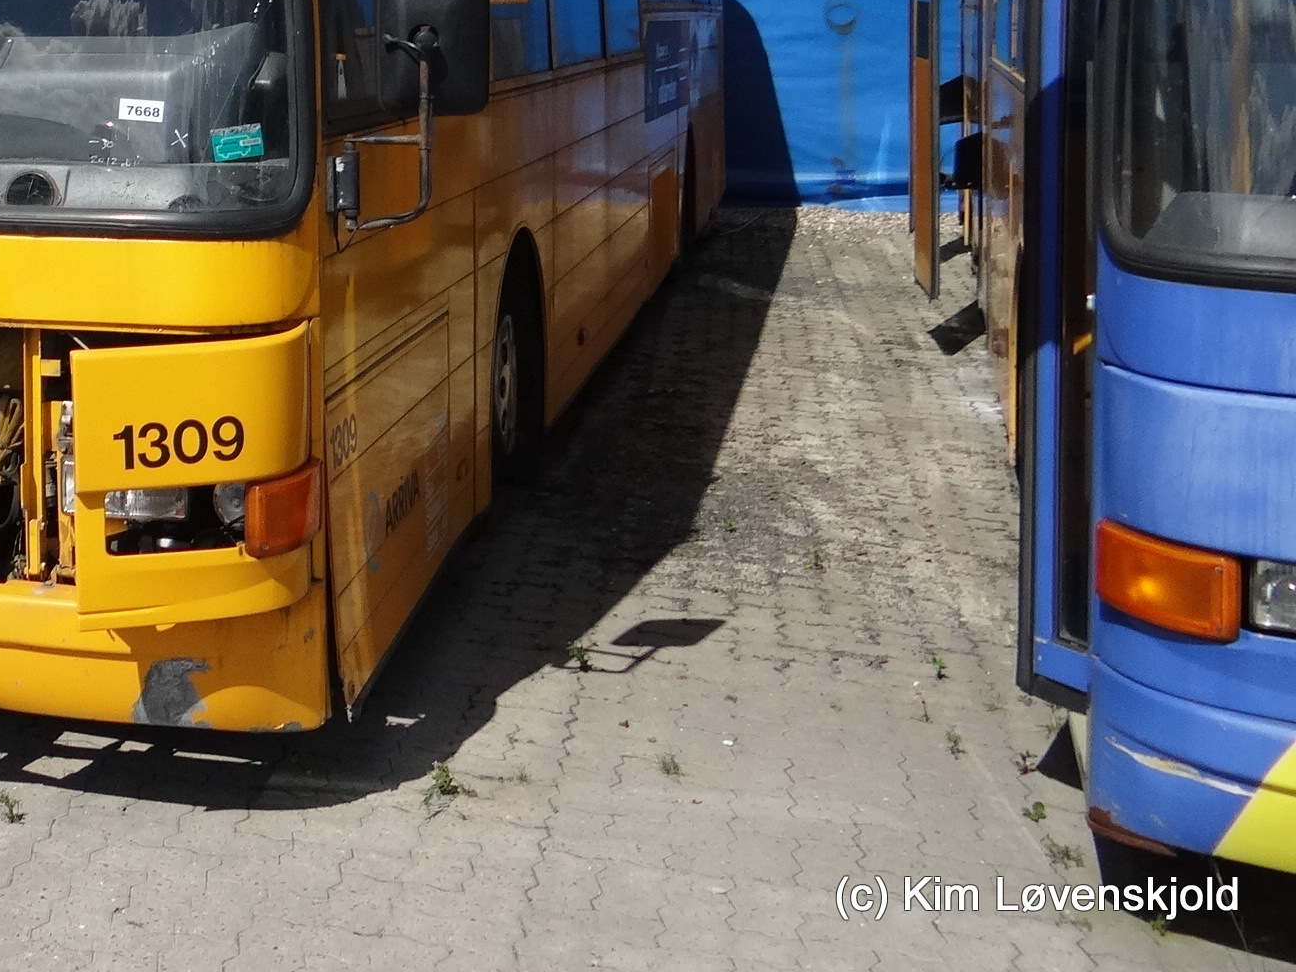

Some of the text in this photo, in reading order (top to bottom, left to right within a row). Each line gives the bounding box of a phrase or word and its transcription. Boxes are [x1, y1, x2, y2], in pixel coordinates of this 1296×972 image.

[126, 105, 160, 118] 7668
[112, 415, 245, 471] 1309
[330, 413, 357, 470] 1309
